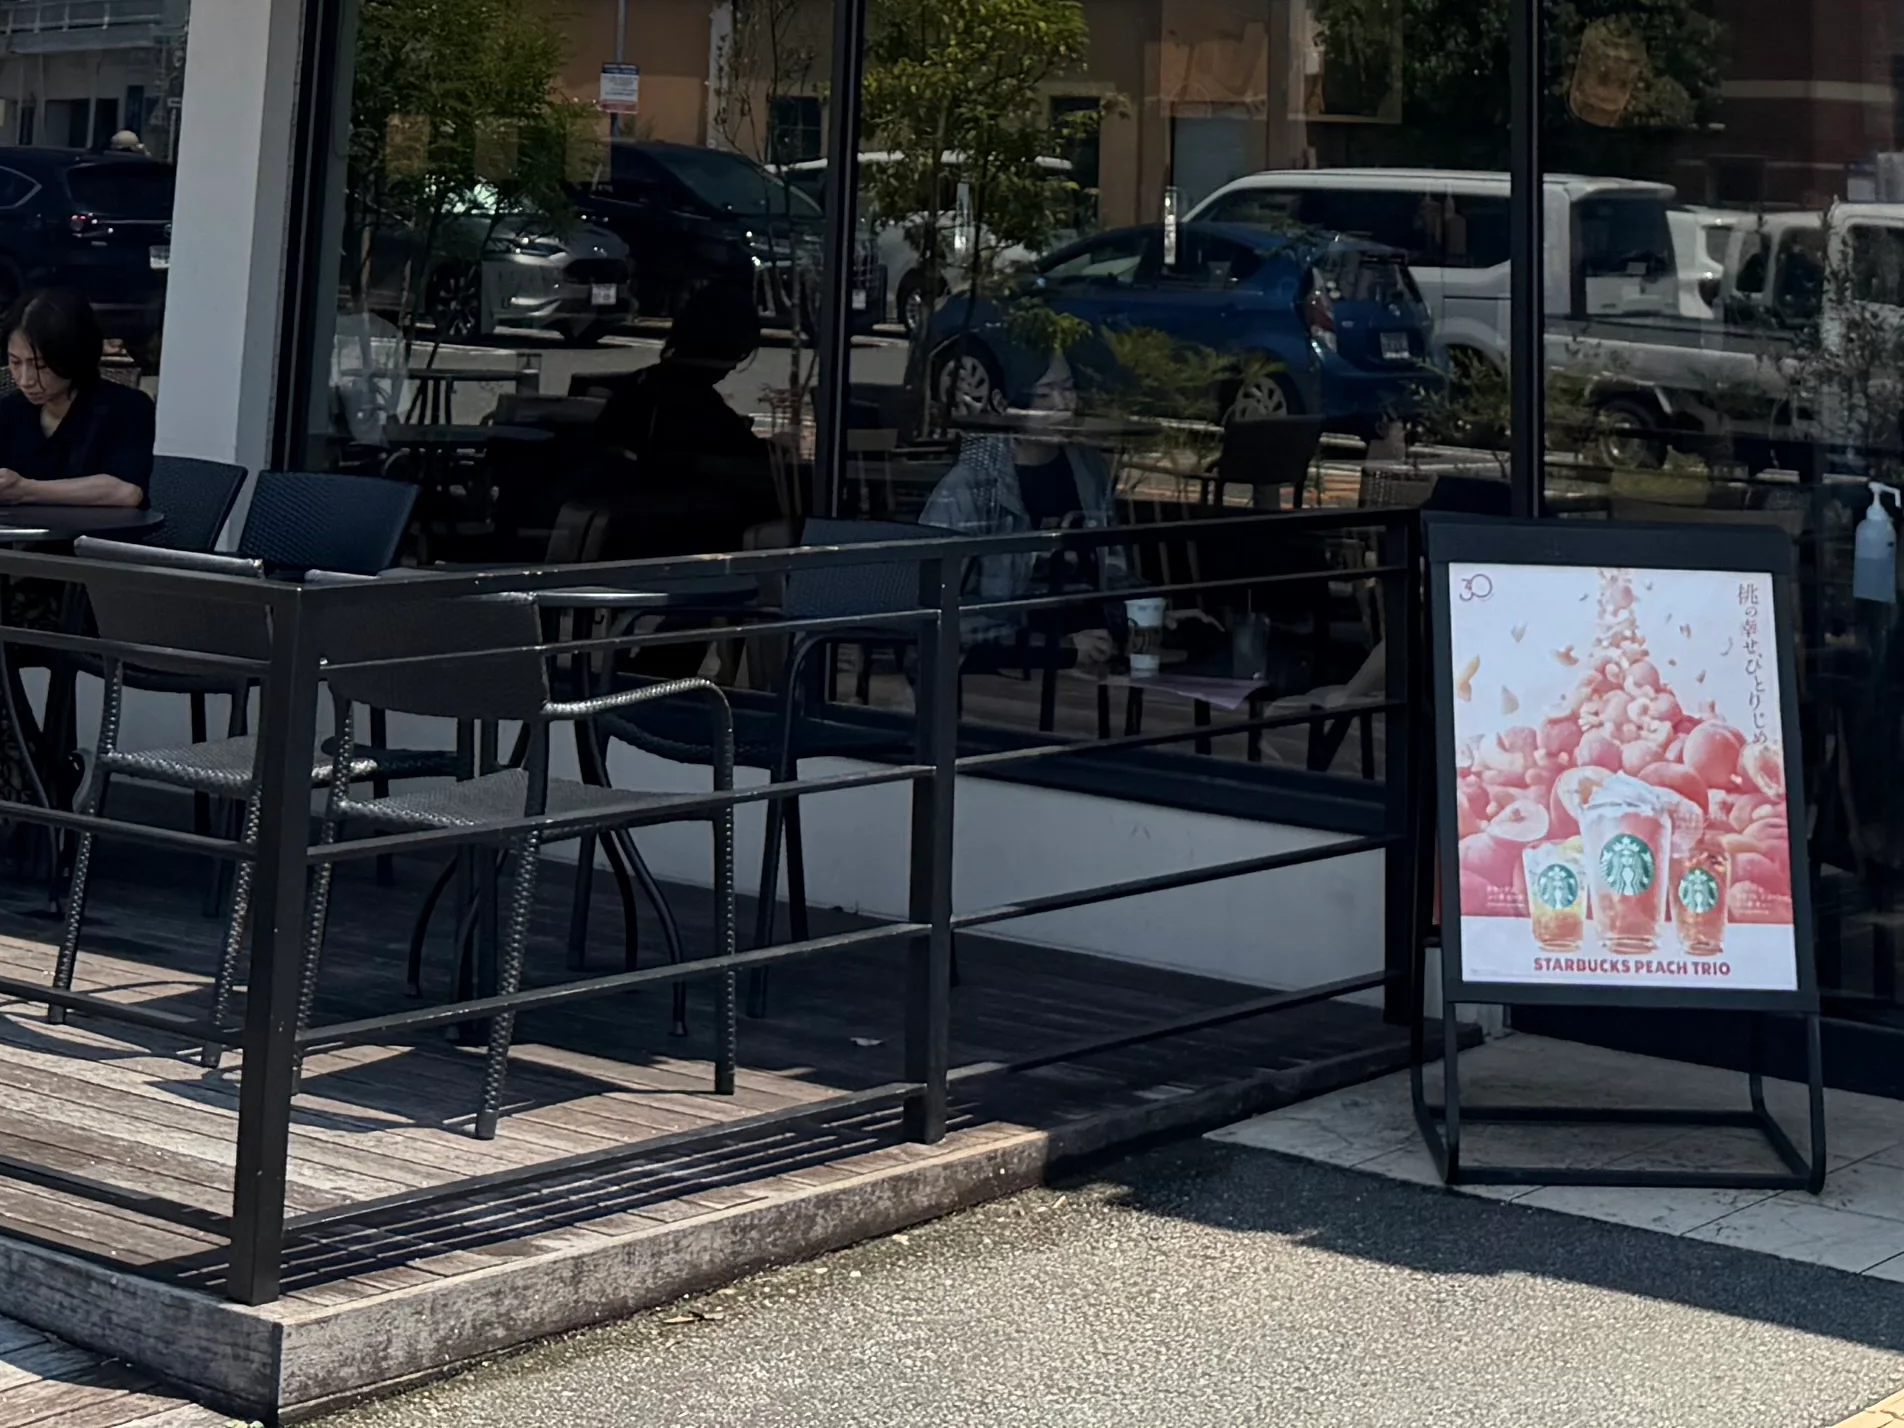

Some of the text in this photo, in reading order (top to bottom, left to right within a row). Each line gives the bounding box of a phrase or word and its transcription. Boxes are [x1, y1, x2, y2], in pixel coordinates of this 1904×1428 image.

[1533, 957, 1631, 974] STARBUCKS
[1634, 959, 1688, 975] PEACH
[1691, 961, 1732, 976] TRIO
